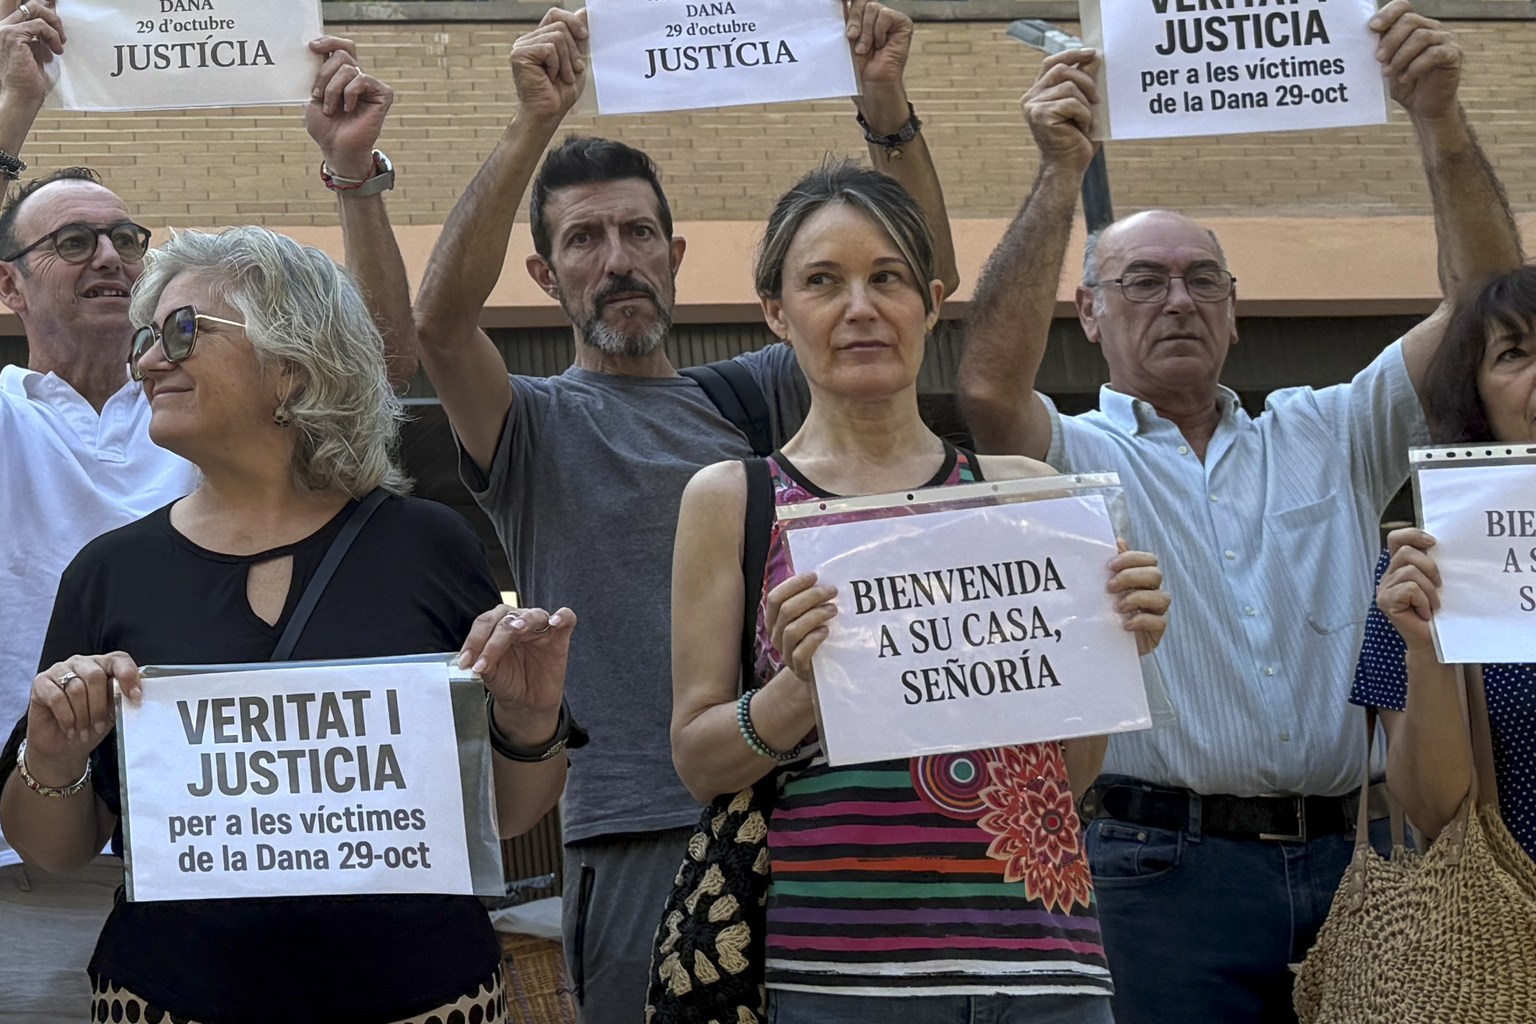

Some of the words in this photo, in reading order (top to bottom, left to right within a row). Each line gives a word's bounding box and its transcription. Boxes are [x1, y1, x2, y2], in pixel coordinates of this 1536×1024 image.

[136, 20, 155, 34] 29
[665, 23, 683, 38] 29
[686, 1, 736, 18] DANA
[1155, 9, 1331, 56] JUSTICIA
[110, 34, 276, 78] JUSTÍCIA
[644, 36, 799, 79] JUSTÍCIA
[1140, 68, 1180, 93] per
[1186, 67, 1200, 85] a
[1205, 61, 1240, 83] les
[1244, 55, 1345, 80] víctimes
[1149, 92, 1177, 115] de
[1183, 91, 1204, 112] la
[1210, 89, 1269, 111] Dana
[1275, 82, 1349, 107] 29-oct
[1502, 547, 1523, 573] A
[849, 556, 1067, 615] BIENVENIDA
[878, 624, 902, 659] A
[909, 616, 952, 654] SU
[962, 605, 1062, 647] CASA,
[901, 648, 1062, 705] SEÑORÍA
[176, 689, 372, 745] VERITAT
[385, 689, 402, 735] I
[186, 743, 407, 797] JUSTICIA
[168, 814, 217, 844] per
[225, 814, 242, 836] a
[250, 806, 293, 835] les
[299, 803, 426, 834] víctimes
[178, 844, 214, 873] de
[222, 844, 248, 872] la
[256, 843, 330, 871] Dana
[337, 840, 432, 870] 29-oct
